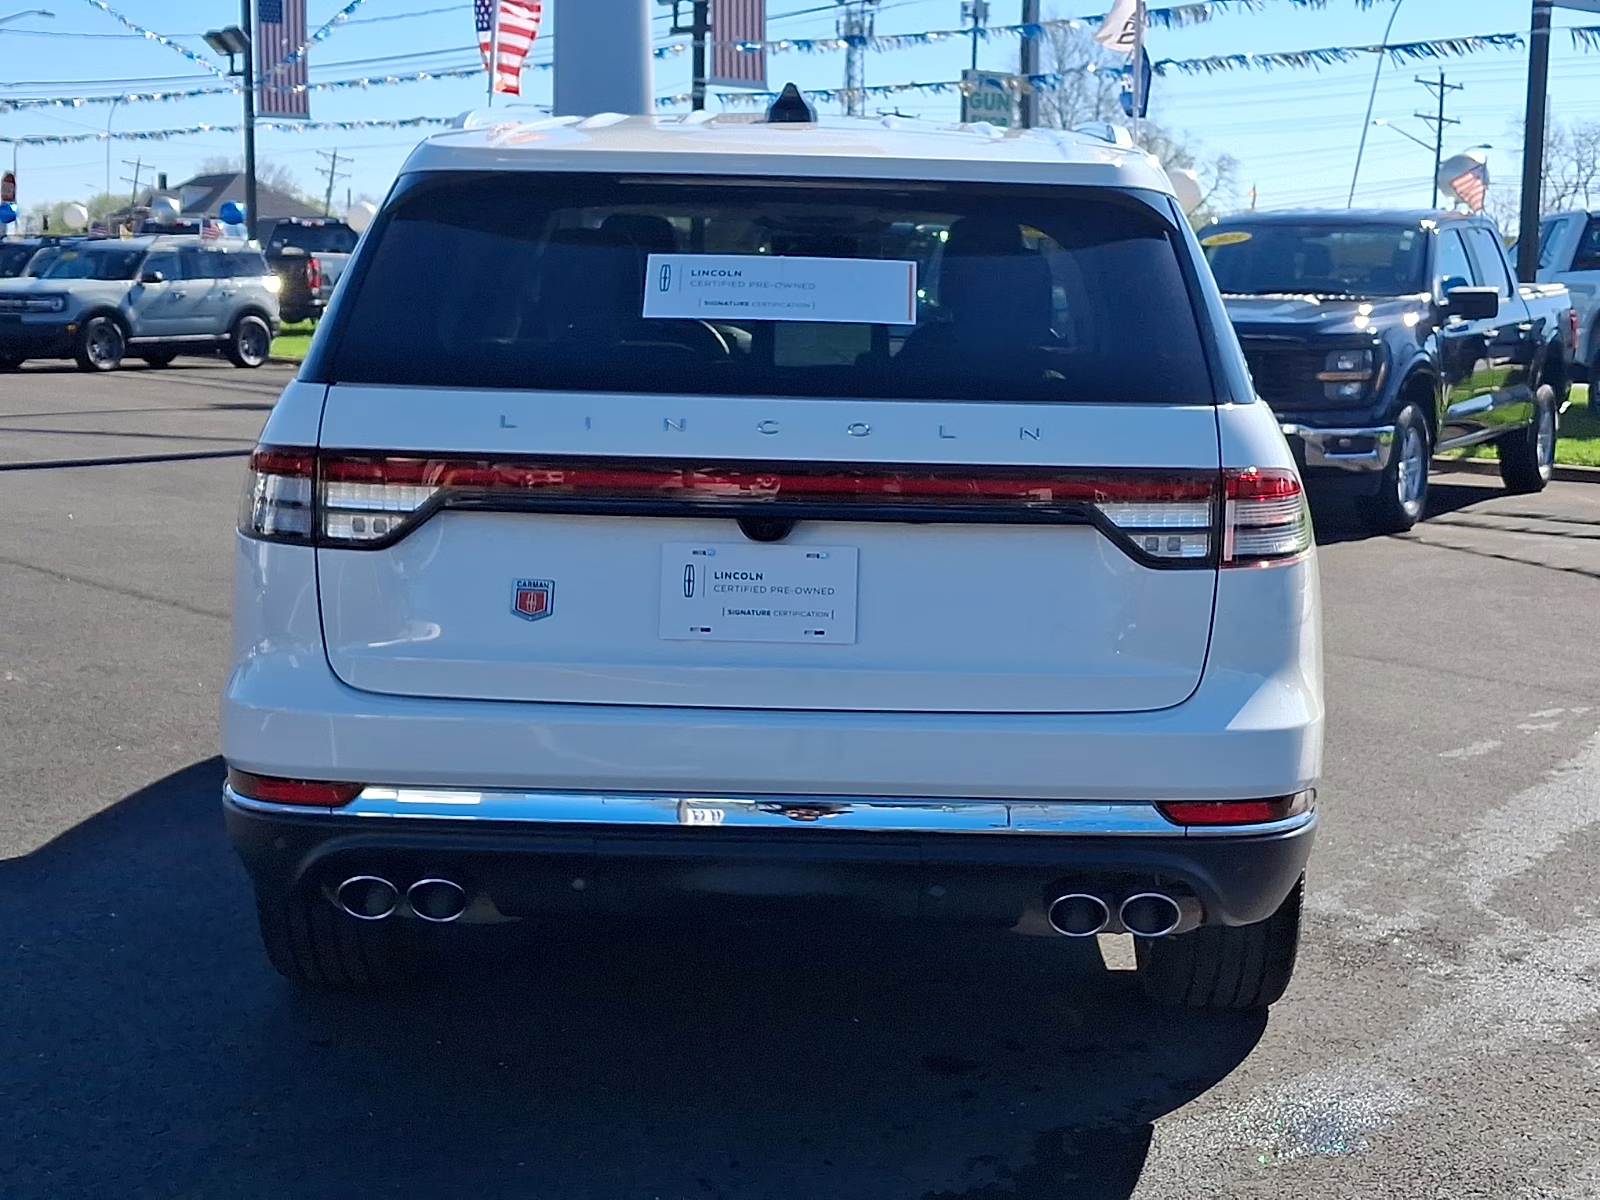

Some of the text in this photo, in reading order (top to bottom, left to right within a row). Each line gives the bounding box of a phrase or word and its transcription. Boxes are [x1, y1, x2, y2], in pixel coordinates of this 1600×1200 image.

[970, 91, 1010, 111] GUN
[690, 269, 743, 277] LINCOLN
[690, 280, 816, 290] CERTIFIED PRE-OWNED
[500, 413, 1045, 441] LINCOLN
[713, 571, 764, 581] LINCOLN
[516, 580, 549, 588] CARMAN
[713, 584, 835, 596] CERTIFIED PRE-OWNED
[727, 608, 830, 618] SIGNATURE CERTIFICATION
